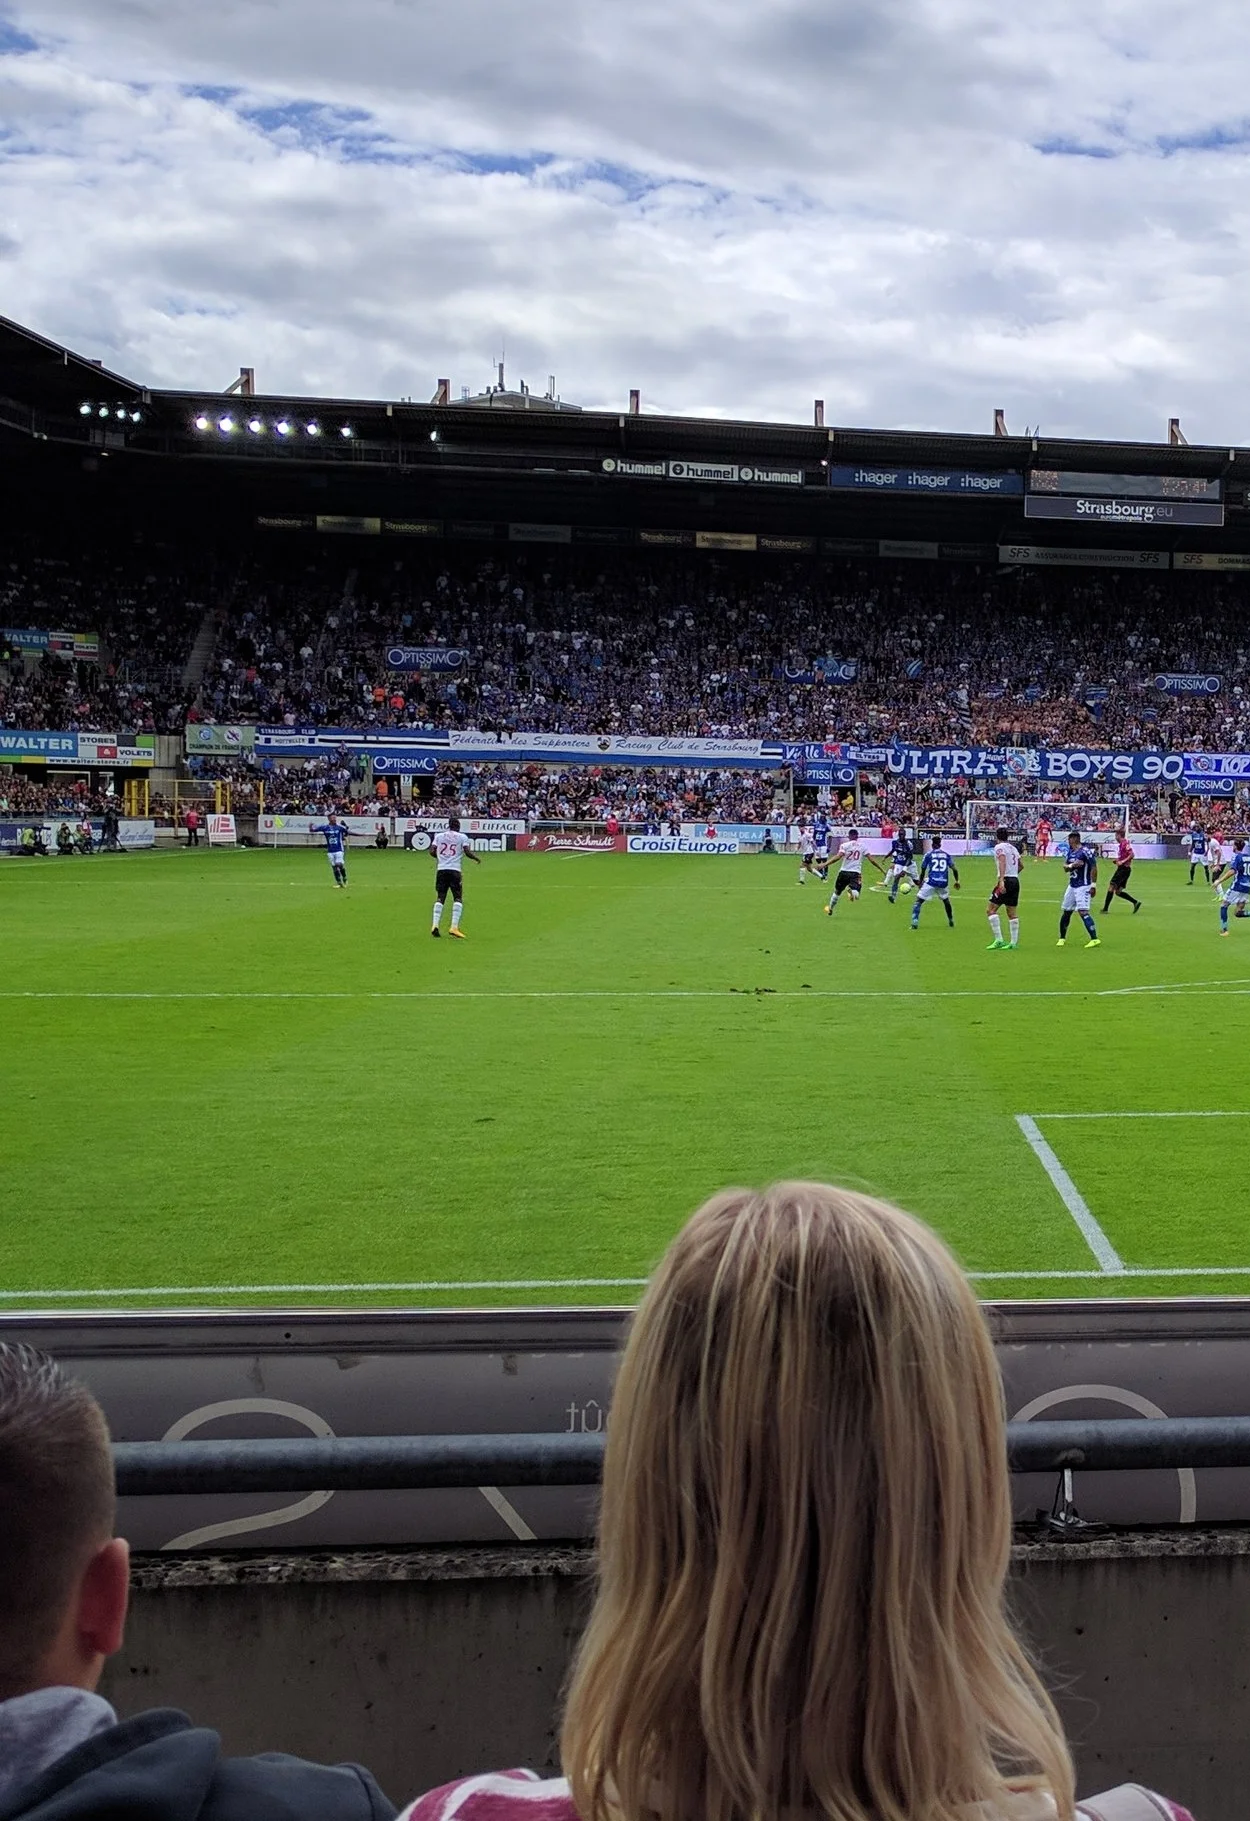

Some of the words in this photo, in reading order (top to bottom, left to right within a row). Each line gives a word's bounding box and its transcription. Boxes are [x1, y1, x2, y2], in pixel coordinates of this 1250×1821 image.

[617, 459, 666, 475] hummel
[687, 463, 734, 479] hummel
[754, 468, 802, 484] hummel
[1009, 547, 1031, 558] SFS
[1139, 552, 1160, 563] SFS
[1183, 554, 1204, 565] SFS
[388, 648, 462, 667] OPTISSIMO
[1154, 675, 1220, 693] OPTISSIMO
[1, 736, 74, 751] WALTER
[511, 736, 527, 746] des
[532, 736, 590, 749] Supporters
[615, 740, 652, 752] Racing
[657, 739, 684, 751] Club
[687, 742, 699, 751] de
[704, 741, 759, 754] Strasbourg
[120, 749, 152, 757] VOLETS
[373, 756, 438, 770] OPTISSIMO
[1046, 752, 1133, 780] BOYS
[1143, 755, 1184, 779] 90
[1220, 756, 1250, 774] KOP
[1178, 776, 1234, 792] OPTISSIMO
[419, 820, 449, 830] EIFFAG
[482, 821, 518, 831] EIFFAGE
[468, 834, 507, 852] mmel
[544, 835, 572, 846] Pierre
[573, 834, 615, 847] Schmidt
[629, 837, 737, 854] CroisiEurope
[439, 842, 457, 857] 25
[846, 850, 861, 861] 20
[931, 860, 948, 873] 29
